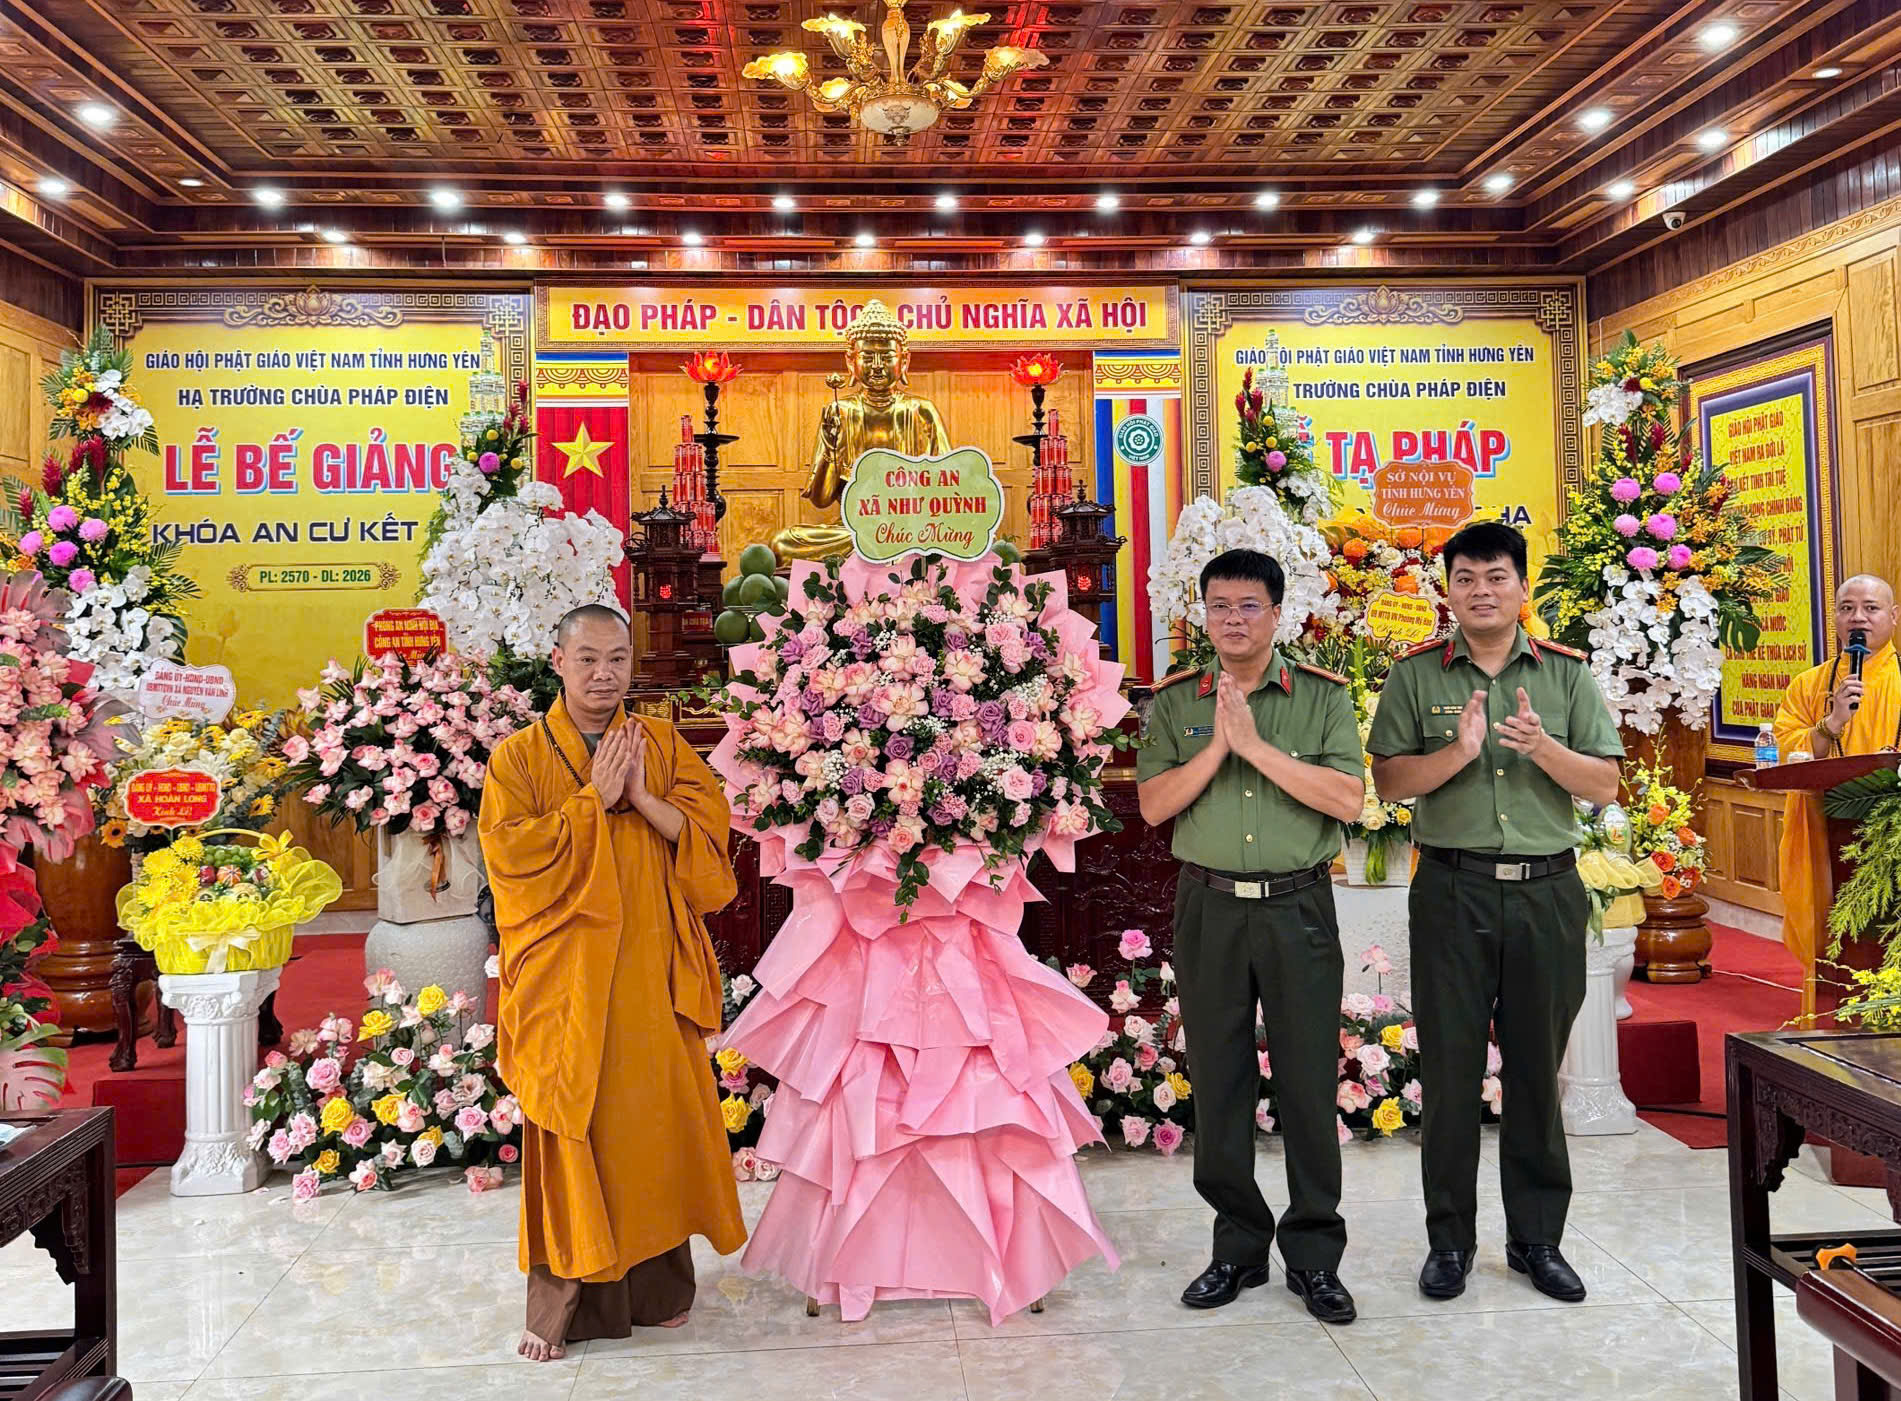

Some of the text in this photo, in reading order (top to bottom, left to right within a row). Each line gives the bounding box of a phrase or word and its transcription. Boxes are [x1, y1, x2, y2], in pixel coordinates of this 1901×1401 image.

[572, 302, 630, 336] ĐẠO
[641, 299, 717, 331] PHÁP
[748, 299, 809, 331] DÂN
[897, 296, 952, 329] CHỦ
[962, 298, 1046, 330] NGHĨA
[1057, 298, 1092, 329] XÃ
[1102, 297, 1147, 334] HỘI
[145, 348, 480, 373] GIÁO HỘI PHẬT GIÁO VIỆT NAM TỈNH HƯNG YÊN
[1236, 344, 1534, 367] GIÁO ỘI PHẬT GIÁO VIỆT NAM TỈNH HƯNG YÊN
[178, 386, 449, 411] HẠ TRƯỜNG CHÙA PHÁP ĐIỆN
[1293, 377, 1506, 400] TRƯỜNG CHÙA PHÁP ĐIỆN
[165, 427, 457, 493] LỄ BẾ GIẢNG
[1326, 431, 1378, 489] TẠ
[1392, 420, 1508, 477] PHÁP
[885, 466, 960, 488] CÔNG AN
[1386, 469, 1457, 485] SỞ NỘI VỤ
[859, 491, 987, 517] XÃ NHƯ QUỲNH
[1381, 485, 1465, 499] TỈNH HƯNG YÊN
[153, 512, 419, 544] KHÓA AN CƯ KẾT
[875, 522, 975, 550] Chúc Mừng
[259, 570, 278, 583] PL:
[281, 570, 309, 583] 2570
[321, 569, 339, 582] DL:
[342, 569, 370, 582] 2026
